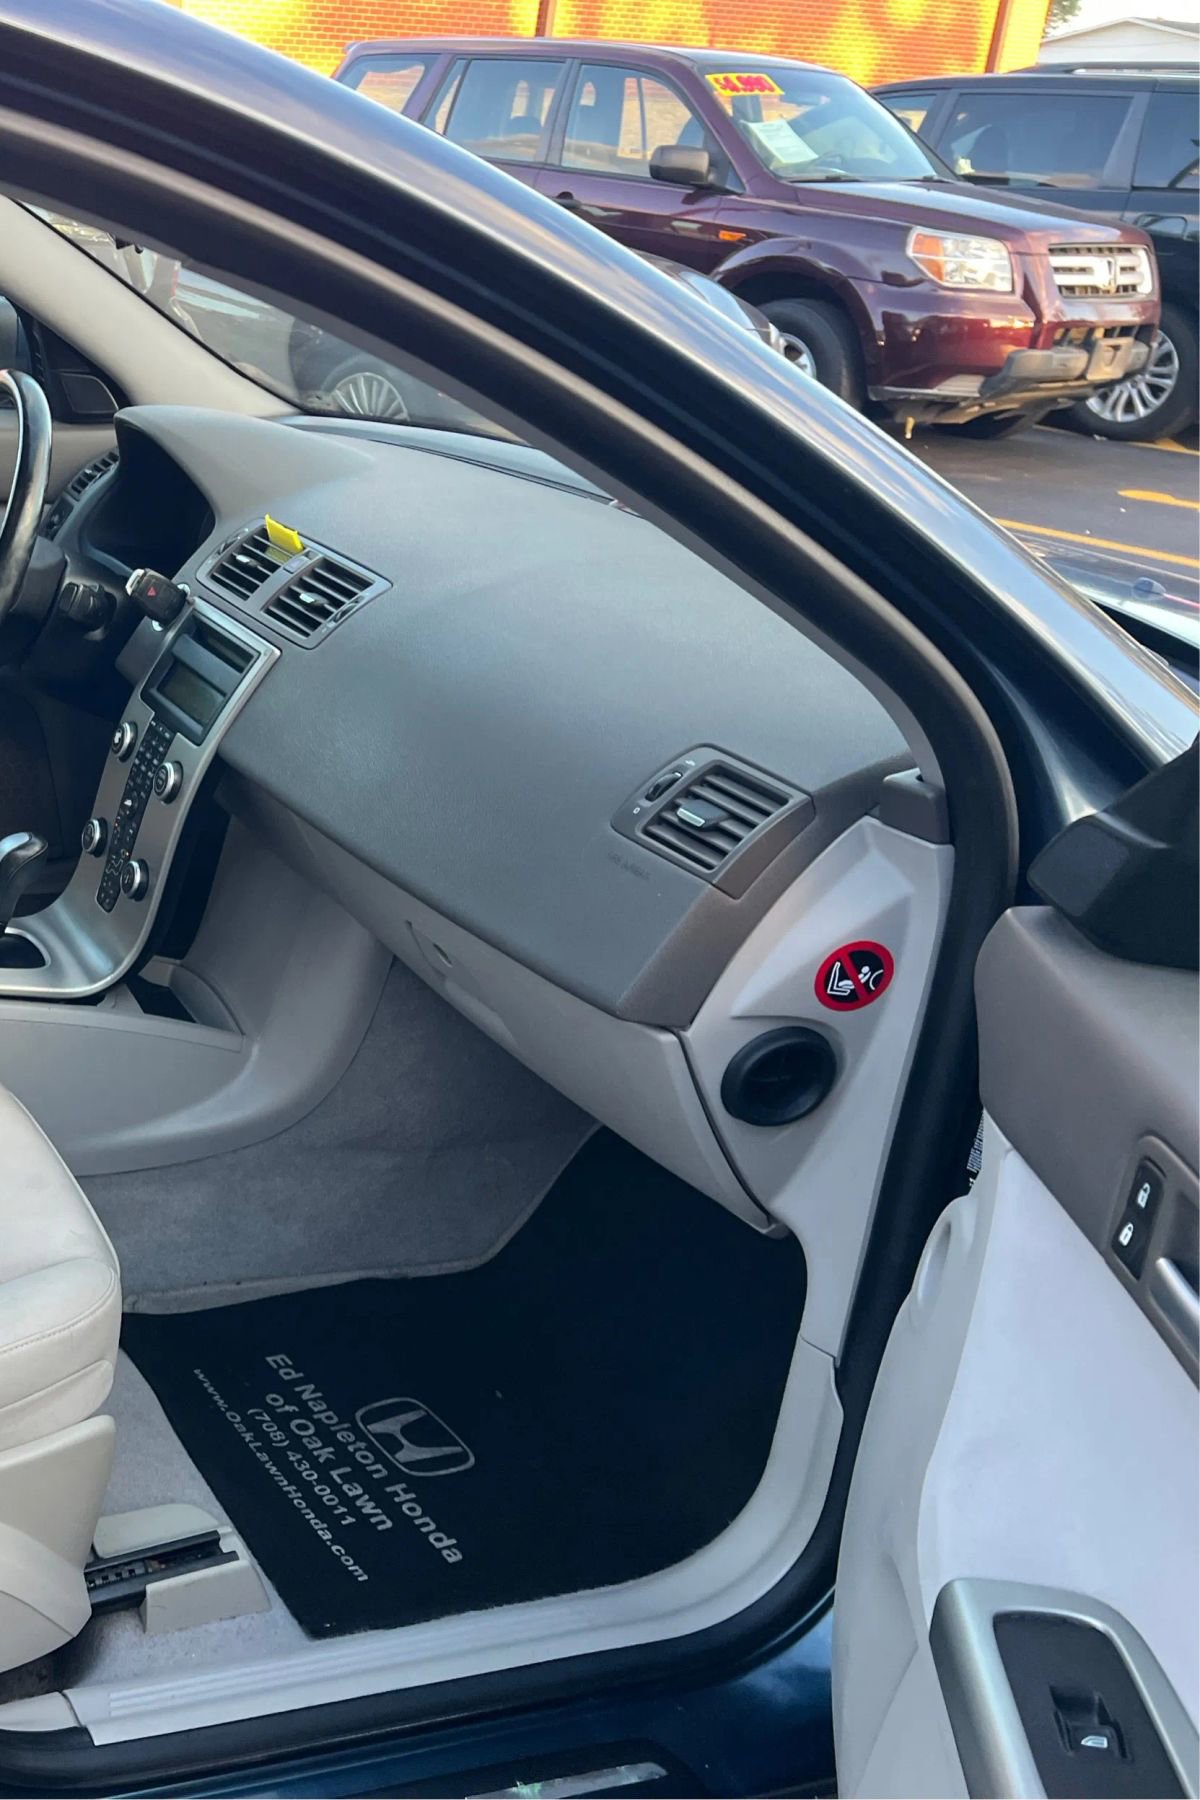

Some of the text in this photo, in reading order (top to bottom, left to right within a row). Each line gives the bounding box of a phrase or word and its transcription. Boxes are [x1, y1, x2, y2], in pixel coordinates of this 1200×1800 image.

[193, 1368, 369, 1581] www.OakLawnHonda.com
[247, 1408, 357, 1526] (708) 430-0011
[265, 1354, 463, 1563] Ed Napleton Honda
[265, 1393, 393, 1531] of Oak Lawn
